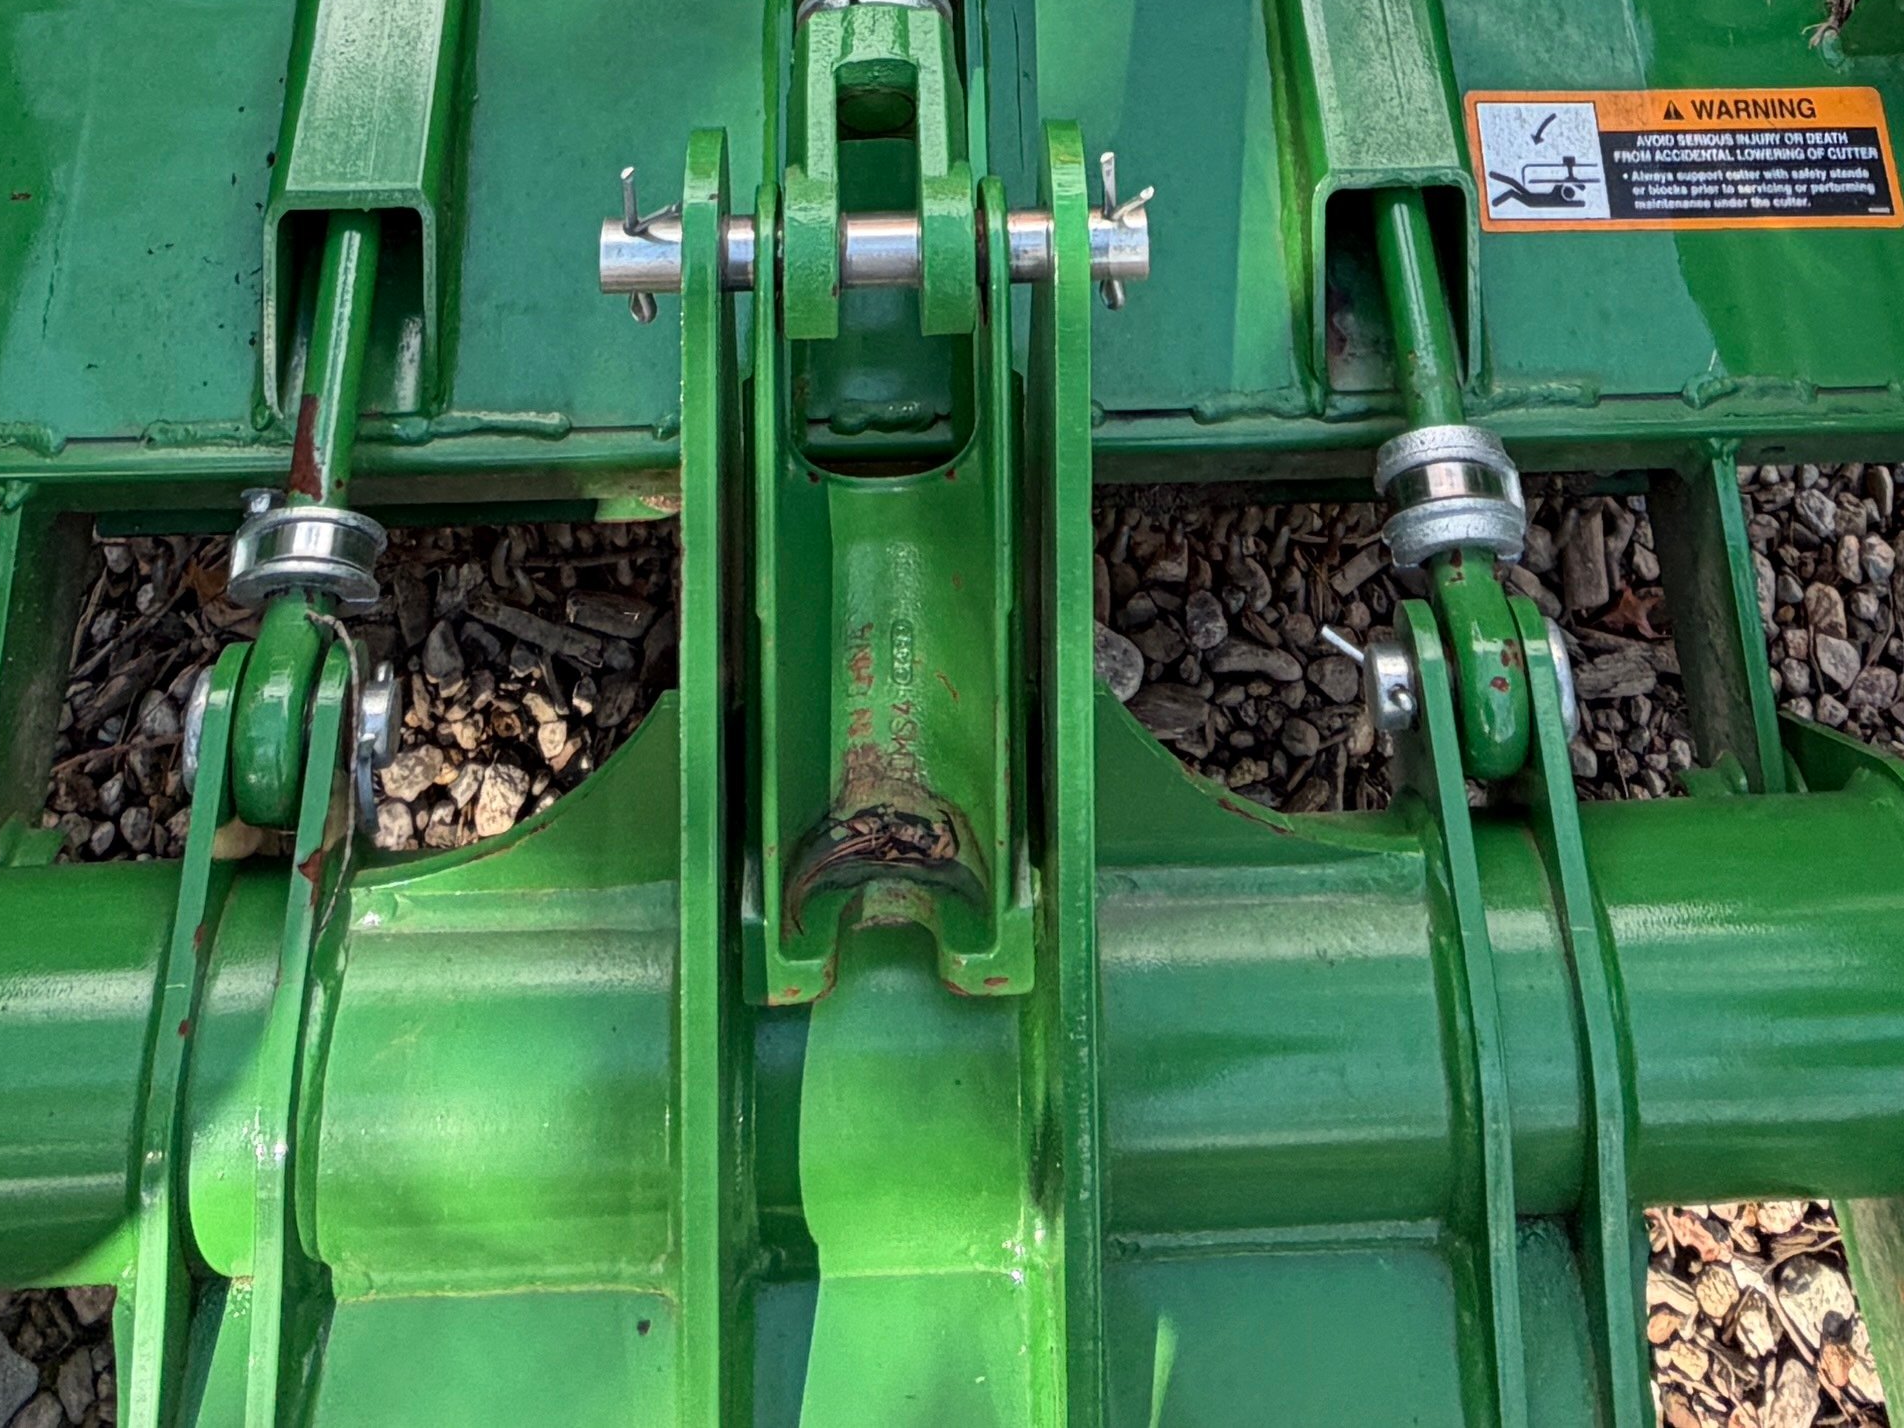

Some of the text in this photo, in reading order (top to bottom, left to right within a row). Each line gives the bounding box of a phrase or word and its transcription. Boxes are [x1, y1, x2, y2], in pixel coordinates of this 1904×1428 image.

[1690, 98, 1816, 119] WARNING
[1635, 132, 1848, 147] AVOID SERIOUS INJURY OR DEATH
[1613, 147, 1878, 162] FROM ACCIDENTAL LOWERING OF CUTTER
[1630, 168, 1869, 182] Always support cutter with safety stands
[1632, 182, 1875, 196] or blocks prior to servicing or performing
[1634, 197, 1811, 209] maintenance under the cutter.
